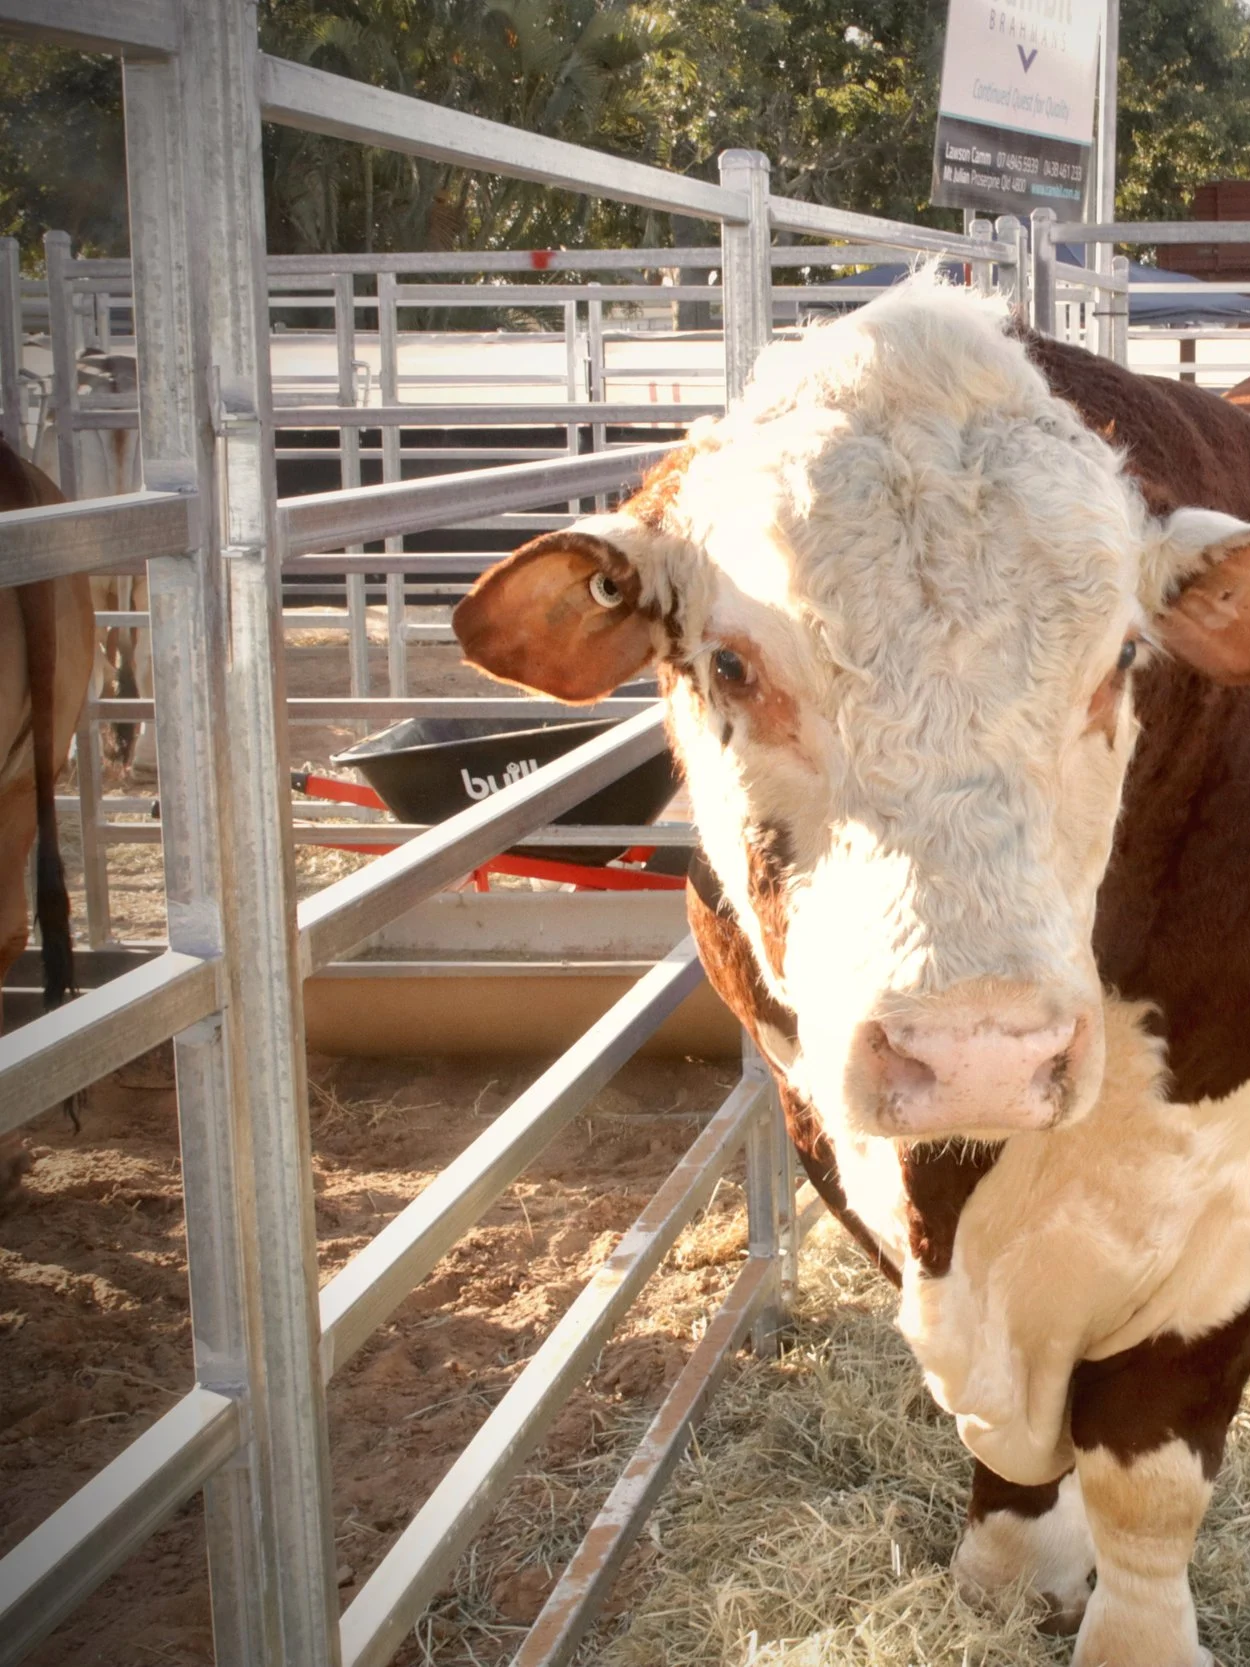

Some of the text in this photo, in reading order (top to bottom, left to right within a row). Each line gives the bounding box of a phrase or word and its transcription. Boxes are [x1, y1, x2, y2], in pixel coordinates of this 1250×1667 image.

[989, 8, 1067, 52] BRAHMANS
[973, 78, 1011, 107] Continued
[1012, 87, 1033, 112] Quest
[1045, 95, 1070, 124] Quality
[945, 141, 970, 162] Lawson
